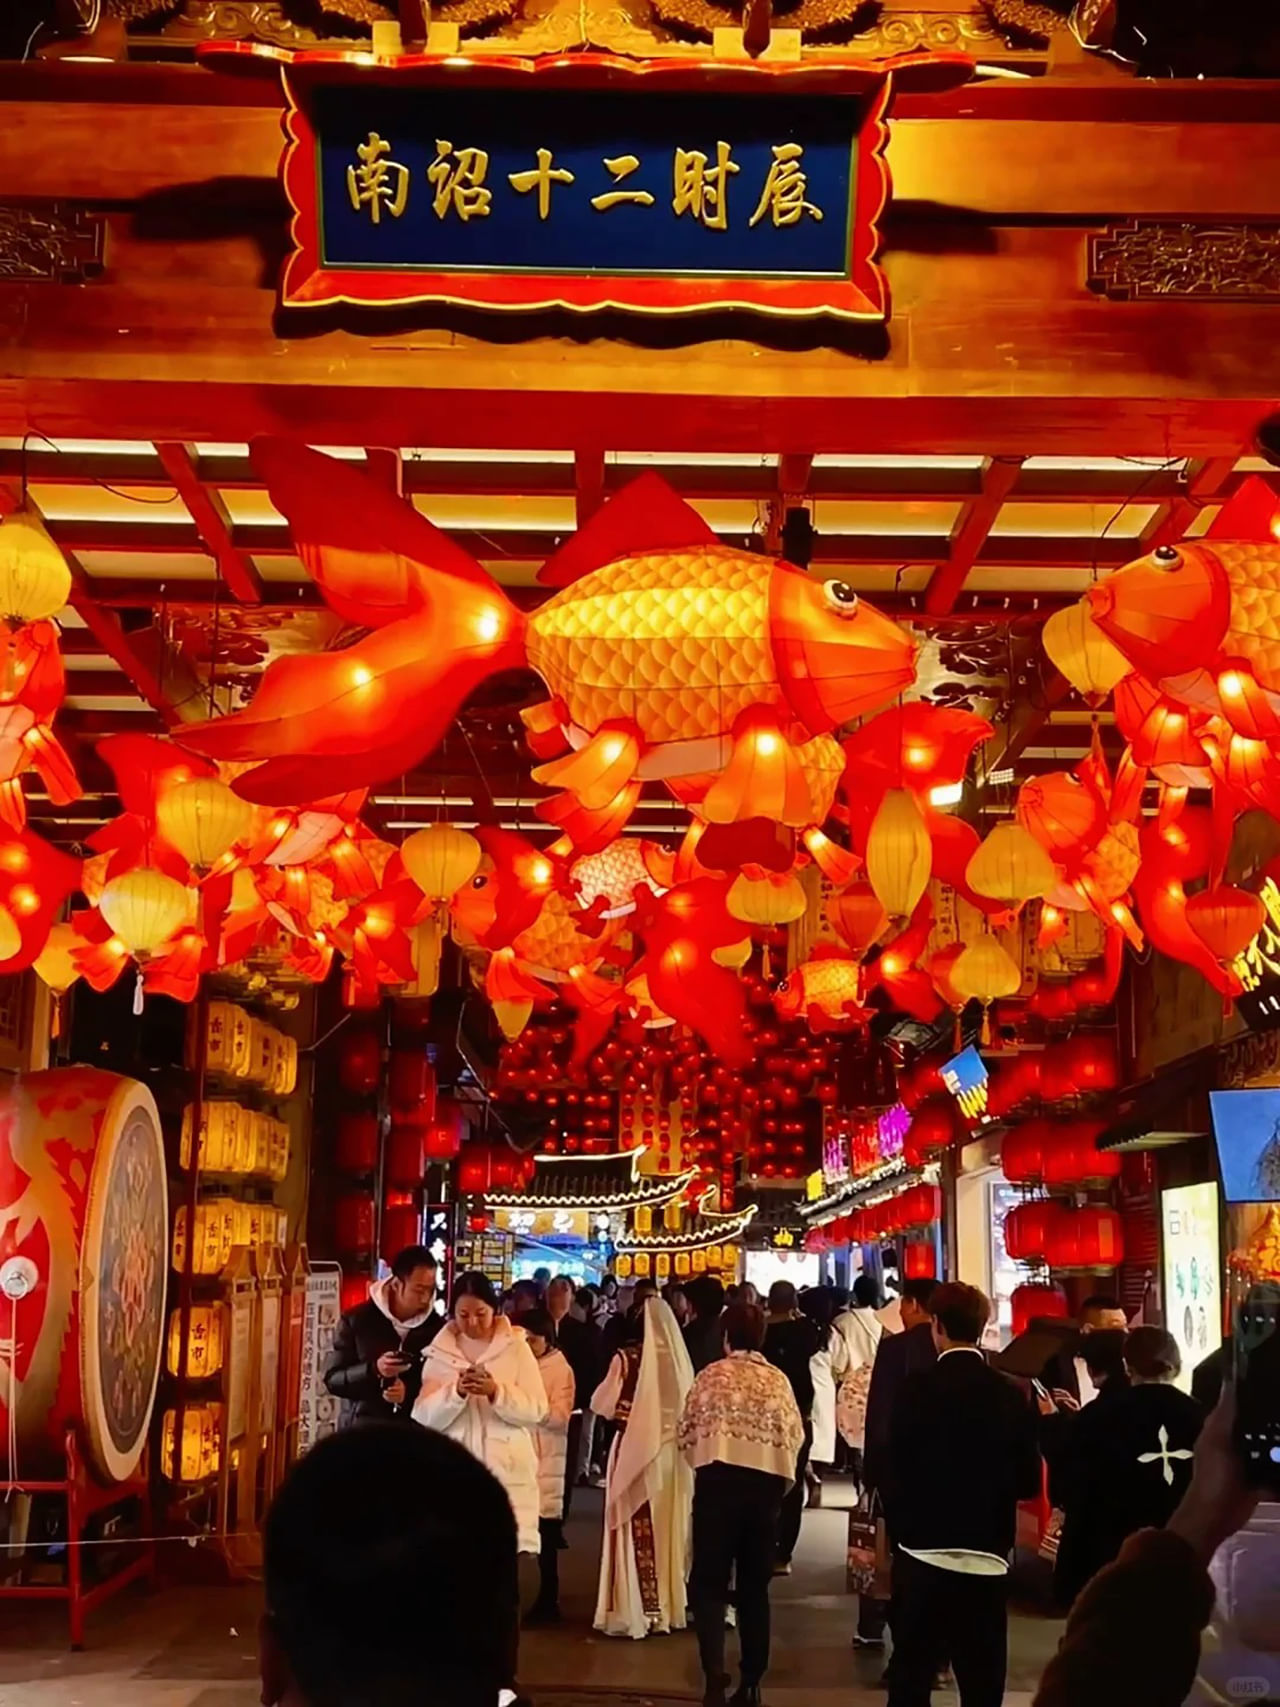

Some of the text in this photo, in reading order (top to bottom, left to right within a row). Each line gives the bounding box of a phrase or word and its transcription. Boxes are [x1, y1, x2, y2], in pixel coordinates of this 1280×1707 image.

[346, 132, 824, 229] 南诏十二时辰
